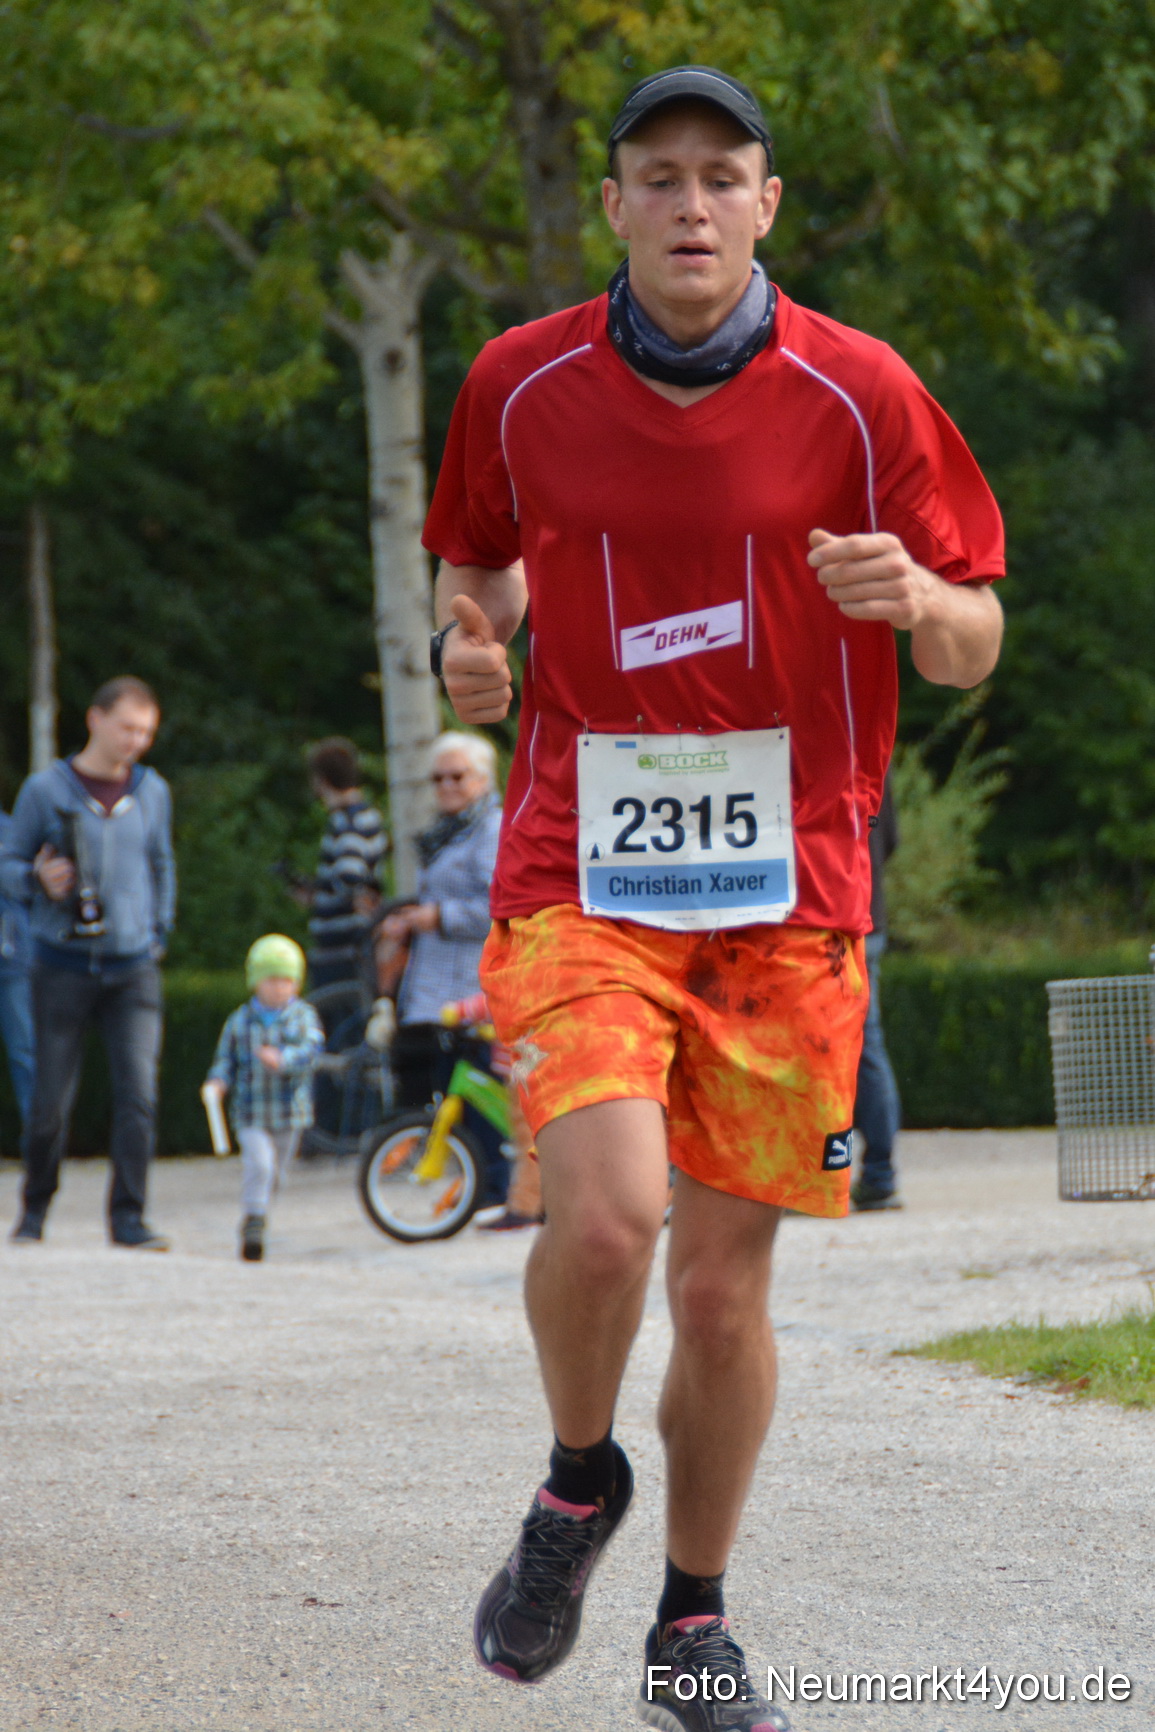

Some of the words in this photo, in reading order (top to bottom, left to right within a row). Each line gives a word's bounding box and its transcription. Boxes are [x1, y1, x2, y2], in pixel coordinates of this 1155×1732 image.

[655, 622, 709, 651] DEHN
[658, 750, 728, 770] BOCK
[612, 792, 758, 853] 2315
[608, 875, 702, 897] Christian
[709, 873, 767, 893] Xaver
